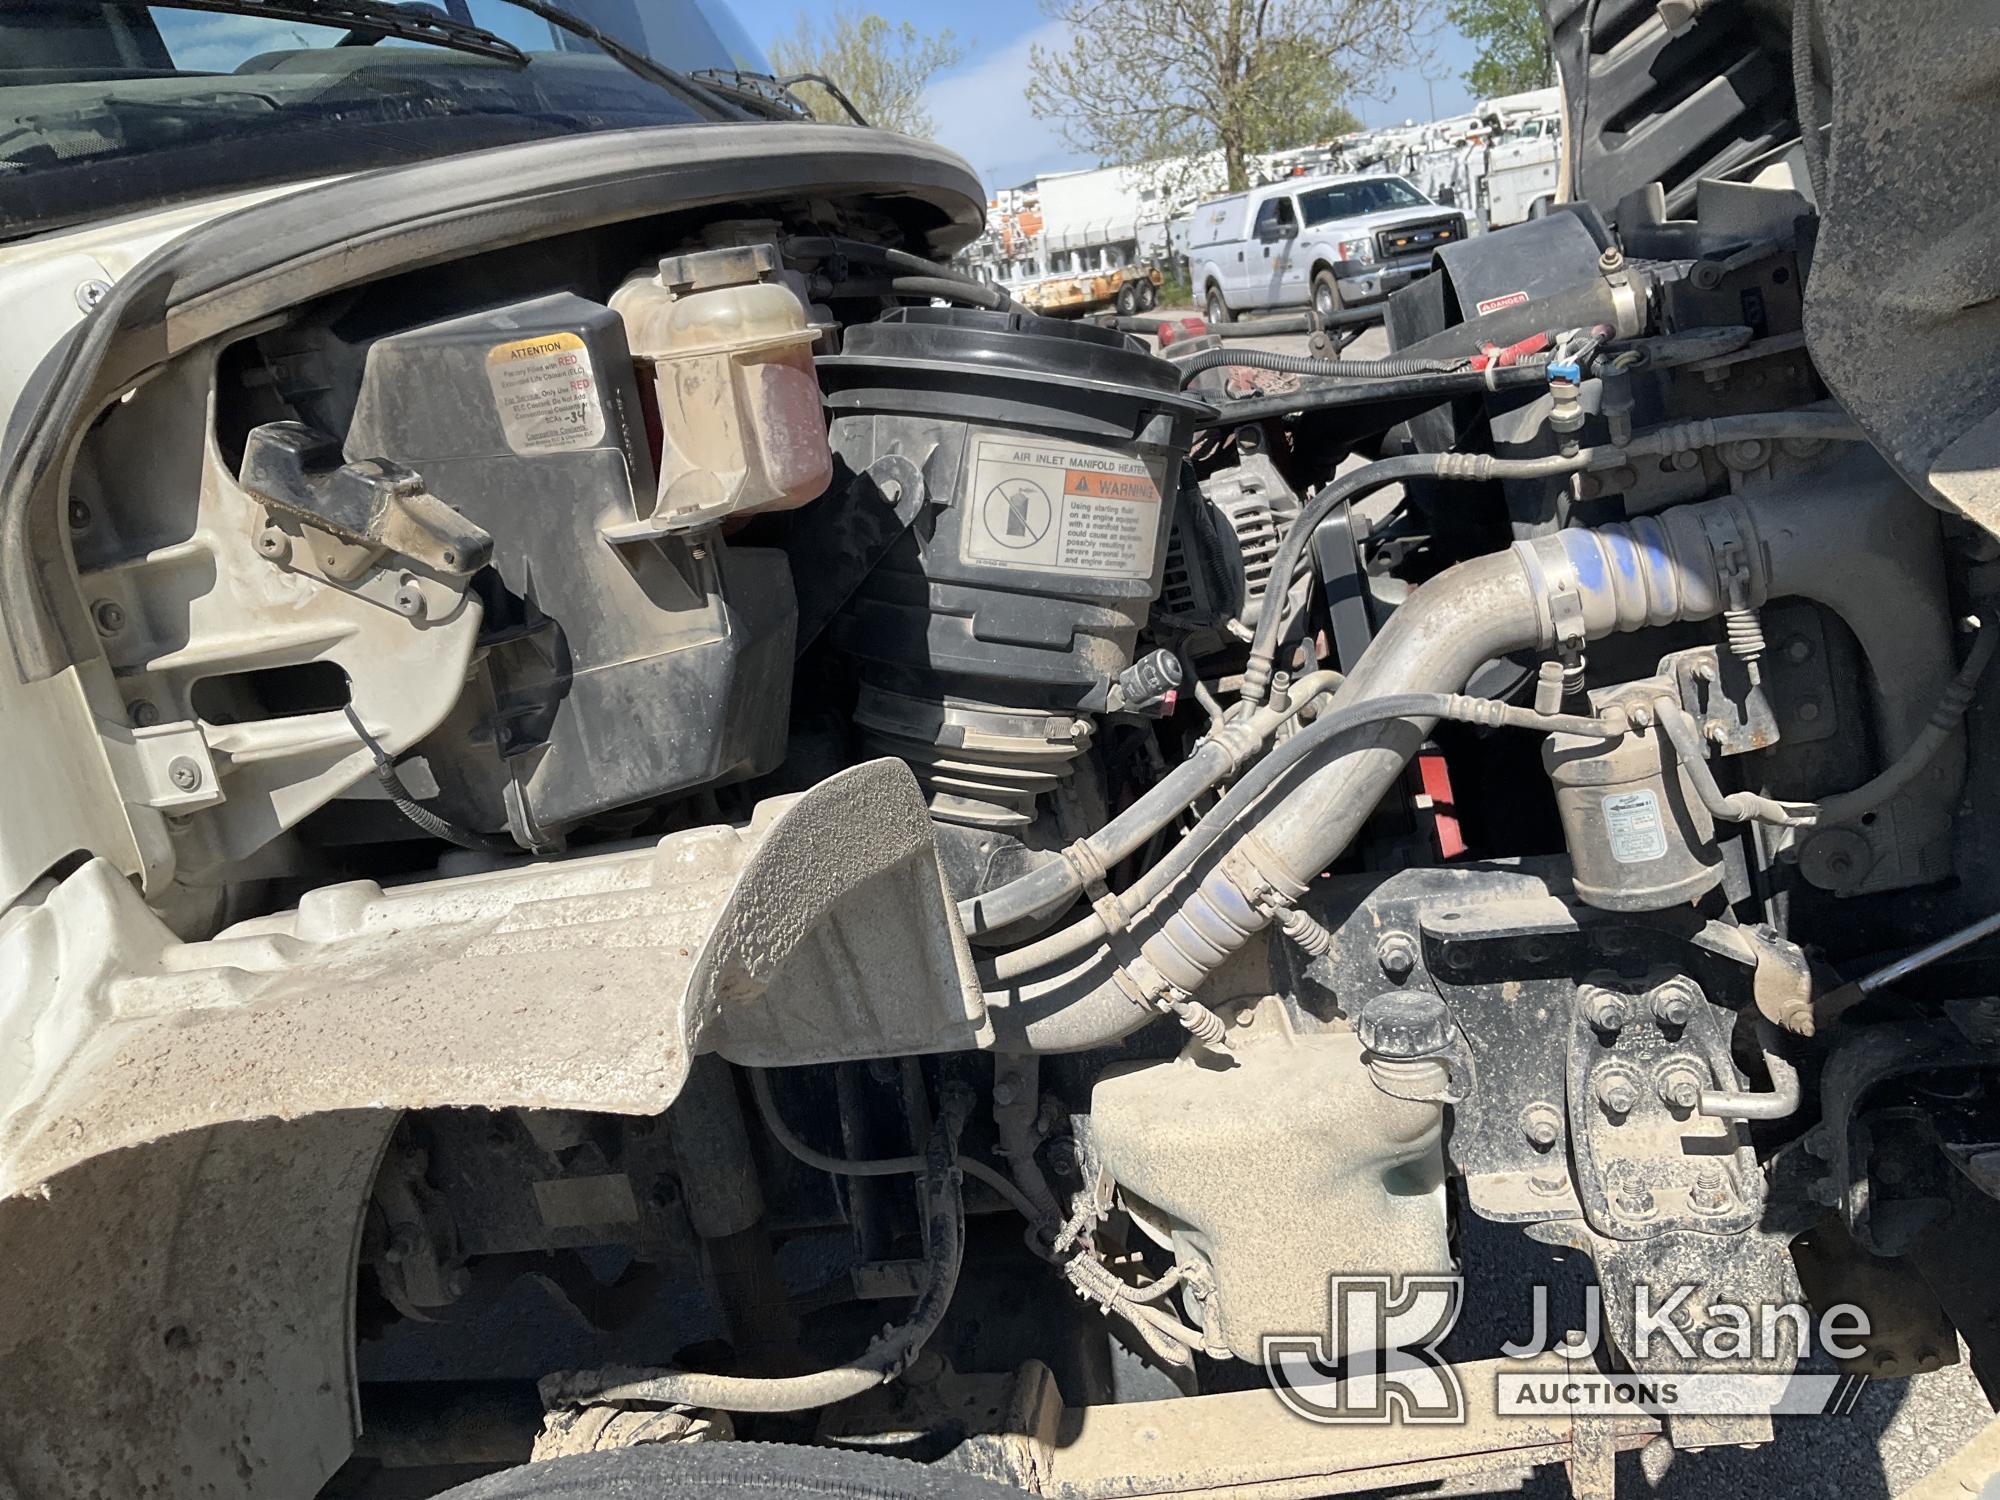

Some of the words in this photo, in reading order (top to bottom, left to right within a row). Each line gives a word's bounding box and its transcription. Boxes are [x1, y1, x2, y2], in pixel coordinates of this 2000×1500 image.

[1490, 295, 1526, 309] DANGER
[511, 342, 561, 359] ATTENTION
[558, 355, 577, 366] RED
[567, 367, 585, 378] (ELC)
[541, 390, 557, 398] Only
[569, 379, 590, 391] RED
[1013, 452, 1031, 461] AIR
[1036, 453, 1065, 465] INLET
[1069, 458, 1115, 471] MANIFOLD
[1118, 463, 1148, 475] HEATER
[1099, 480, 1154, 498] WARNING
[1070, 502, 1091, 512] Using
[1095, 504, 1119, 514] starting
[1092, 514, 1114, 522] engine
[1092, 523, 1119, 531] manifold
[1067, 530, 1087, 538] could
[1066, 539, 1096, 548] possibly
[1092, 549, 1119, 558] personal
[1080, 558, 1103, 566] engine
